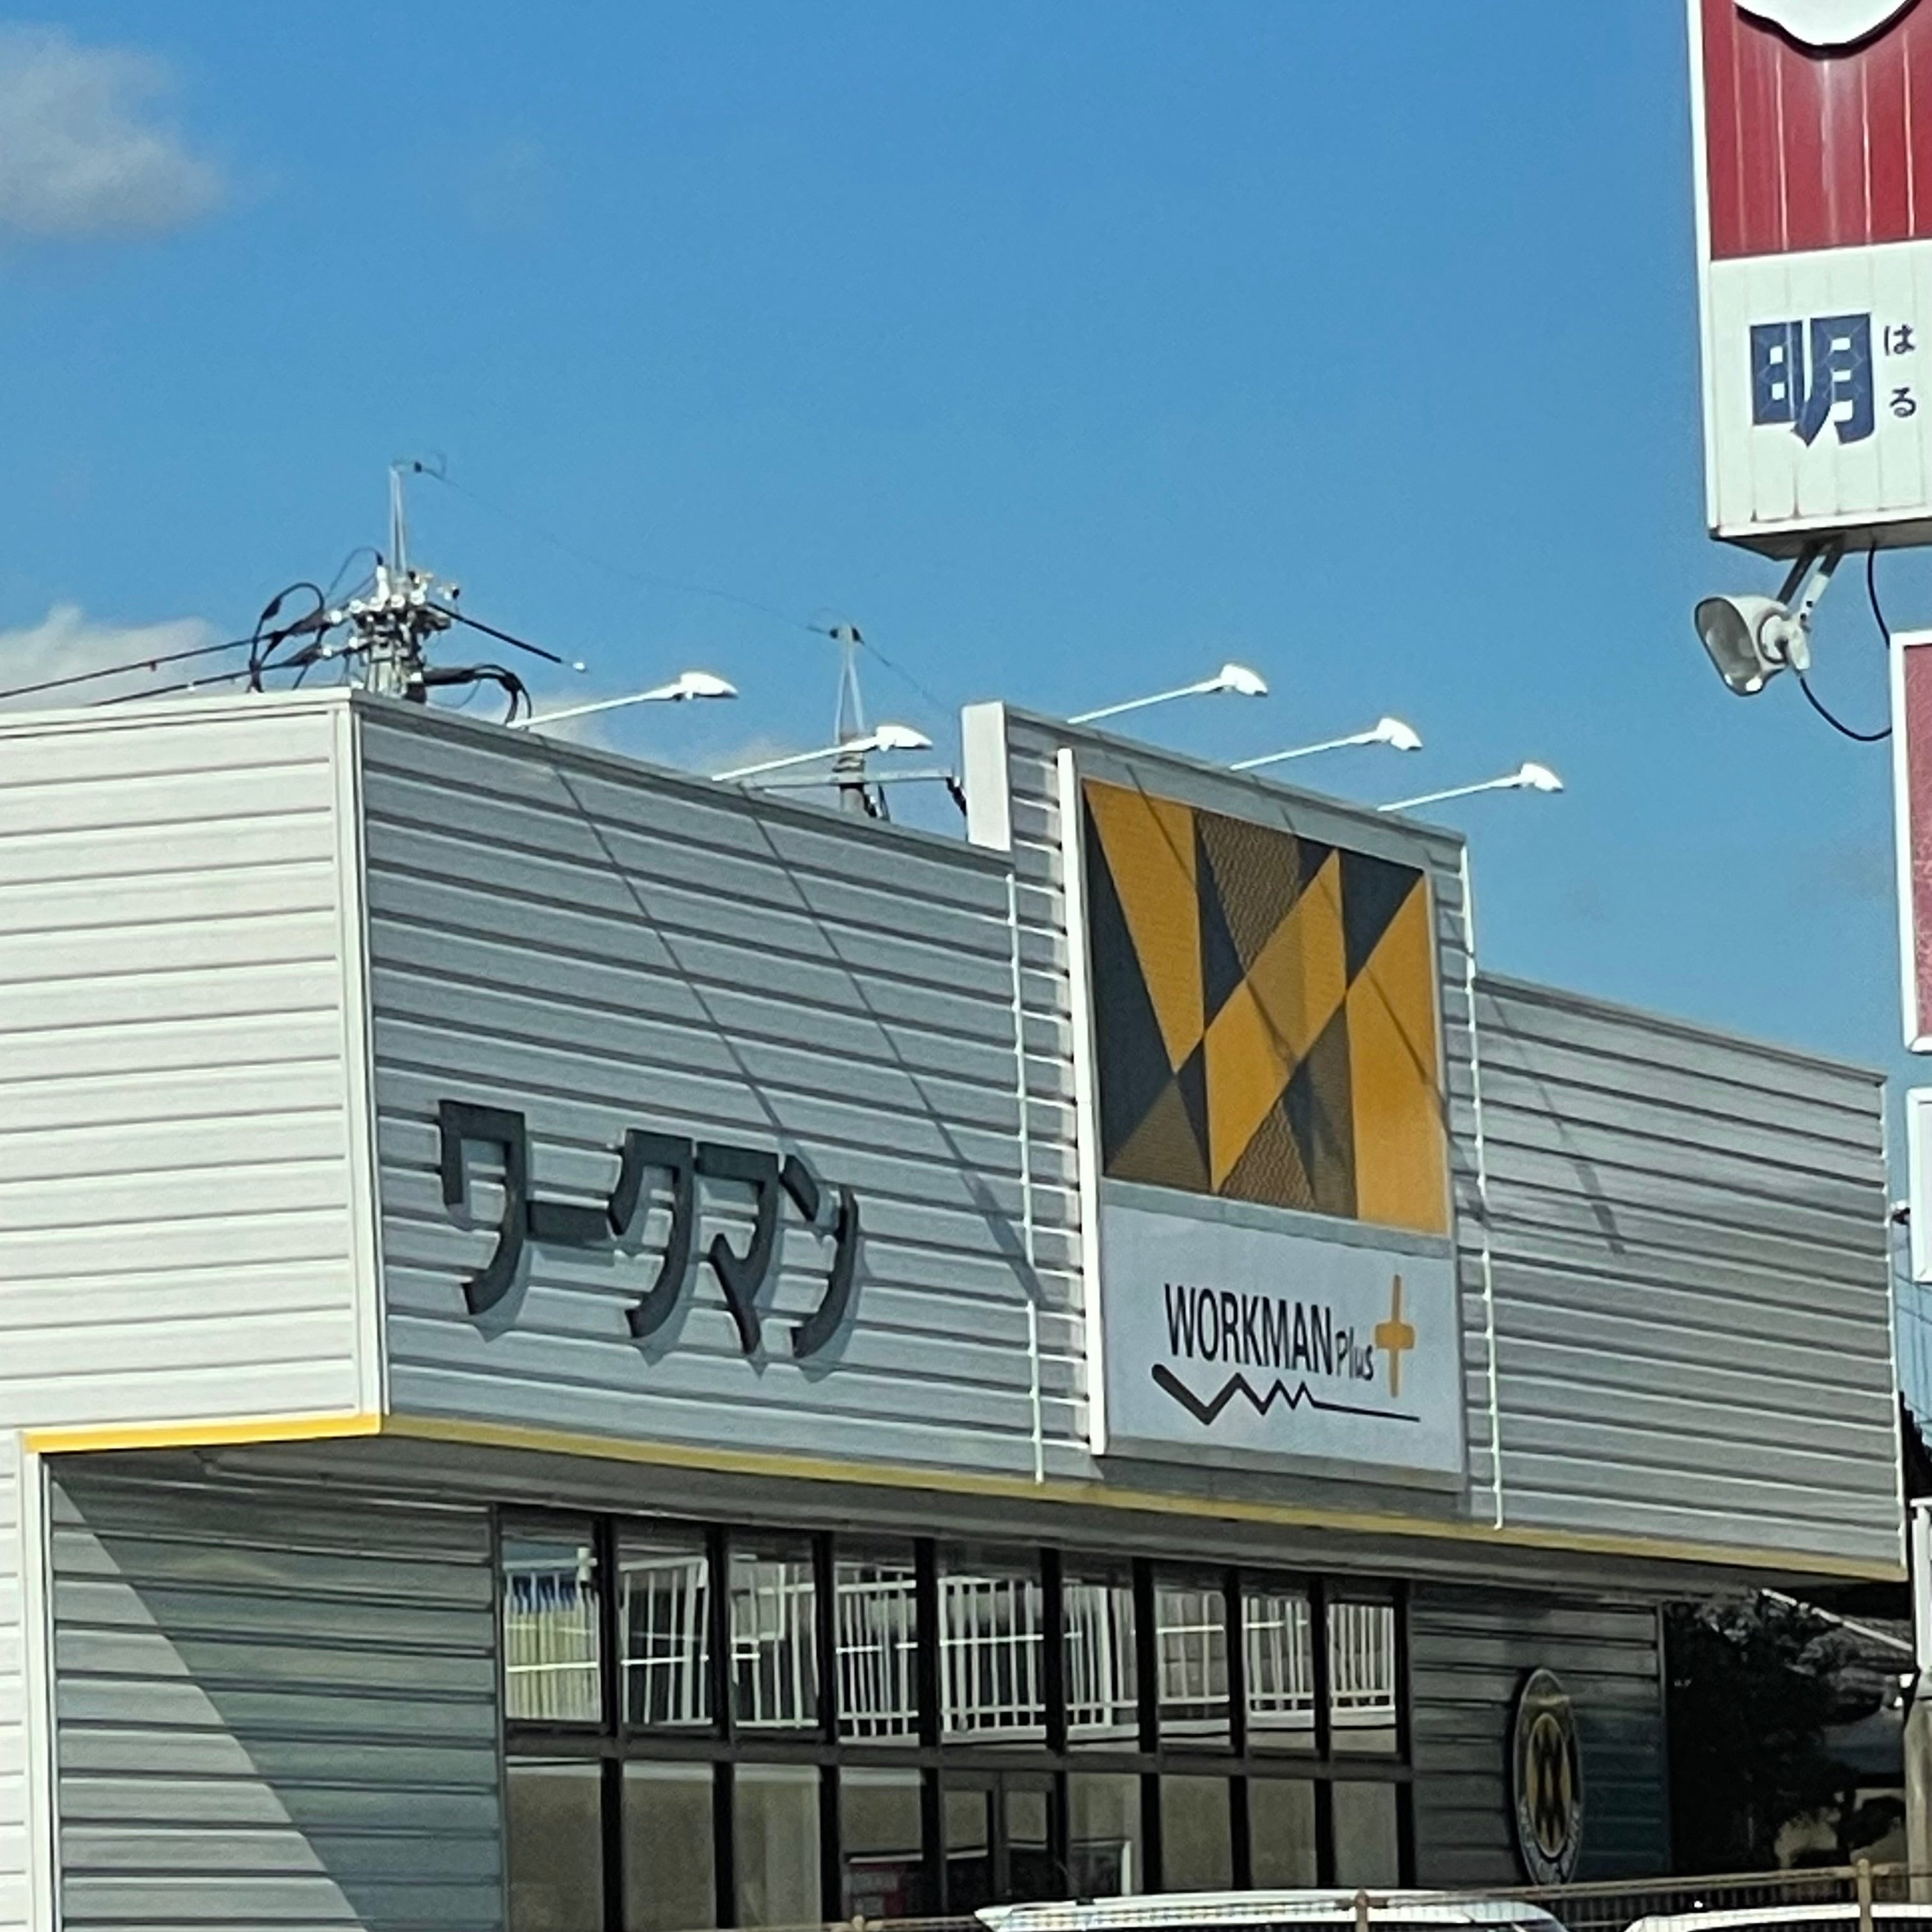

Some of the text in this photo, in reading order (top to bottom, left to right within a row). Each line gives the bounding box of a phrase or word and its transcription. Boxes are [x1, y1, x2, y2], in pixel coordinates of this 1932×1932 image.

[1750, 313, 1875, 447] 明
[1883, 324, 1917, 418] はる
[438, 1100, 859, 1359] ワークマン
[1165, 1284, 1333, 1375] WORKMAN
